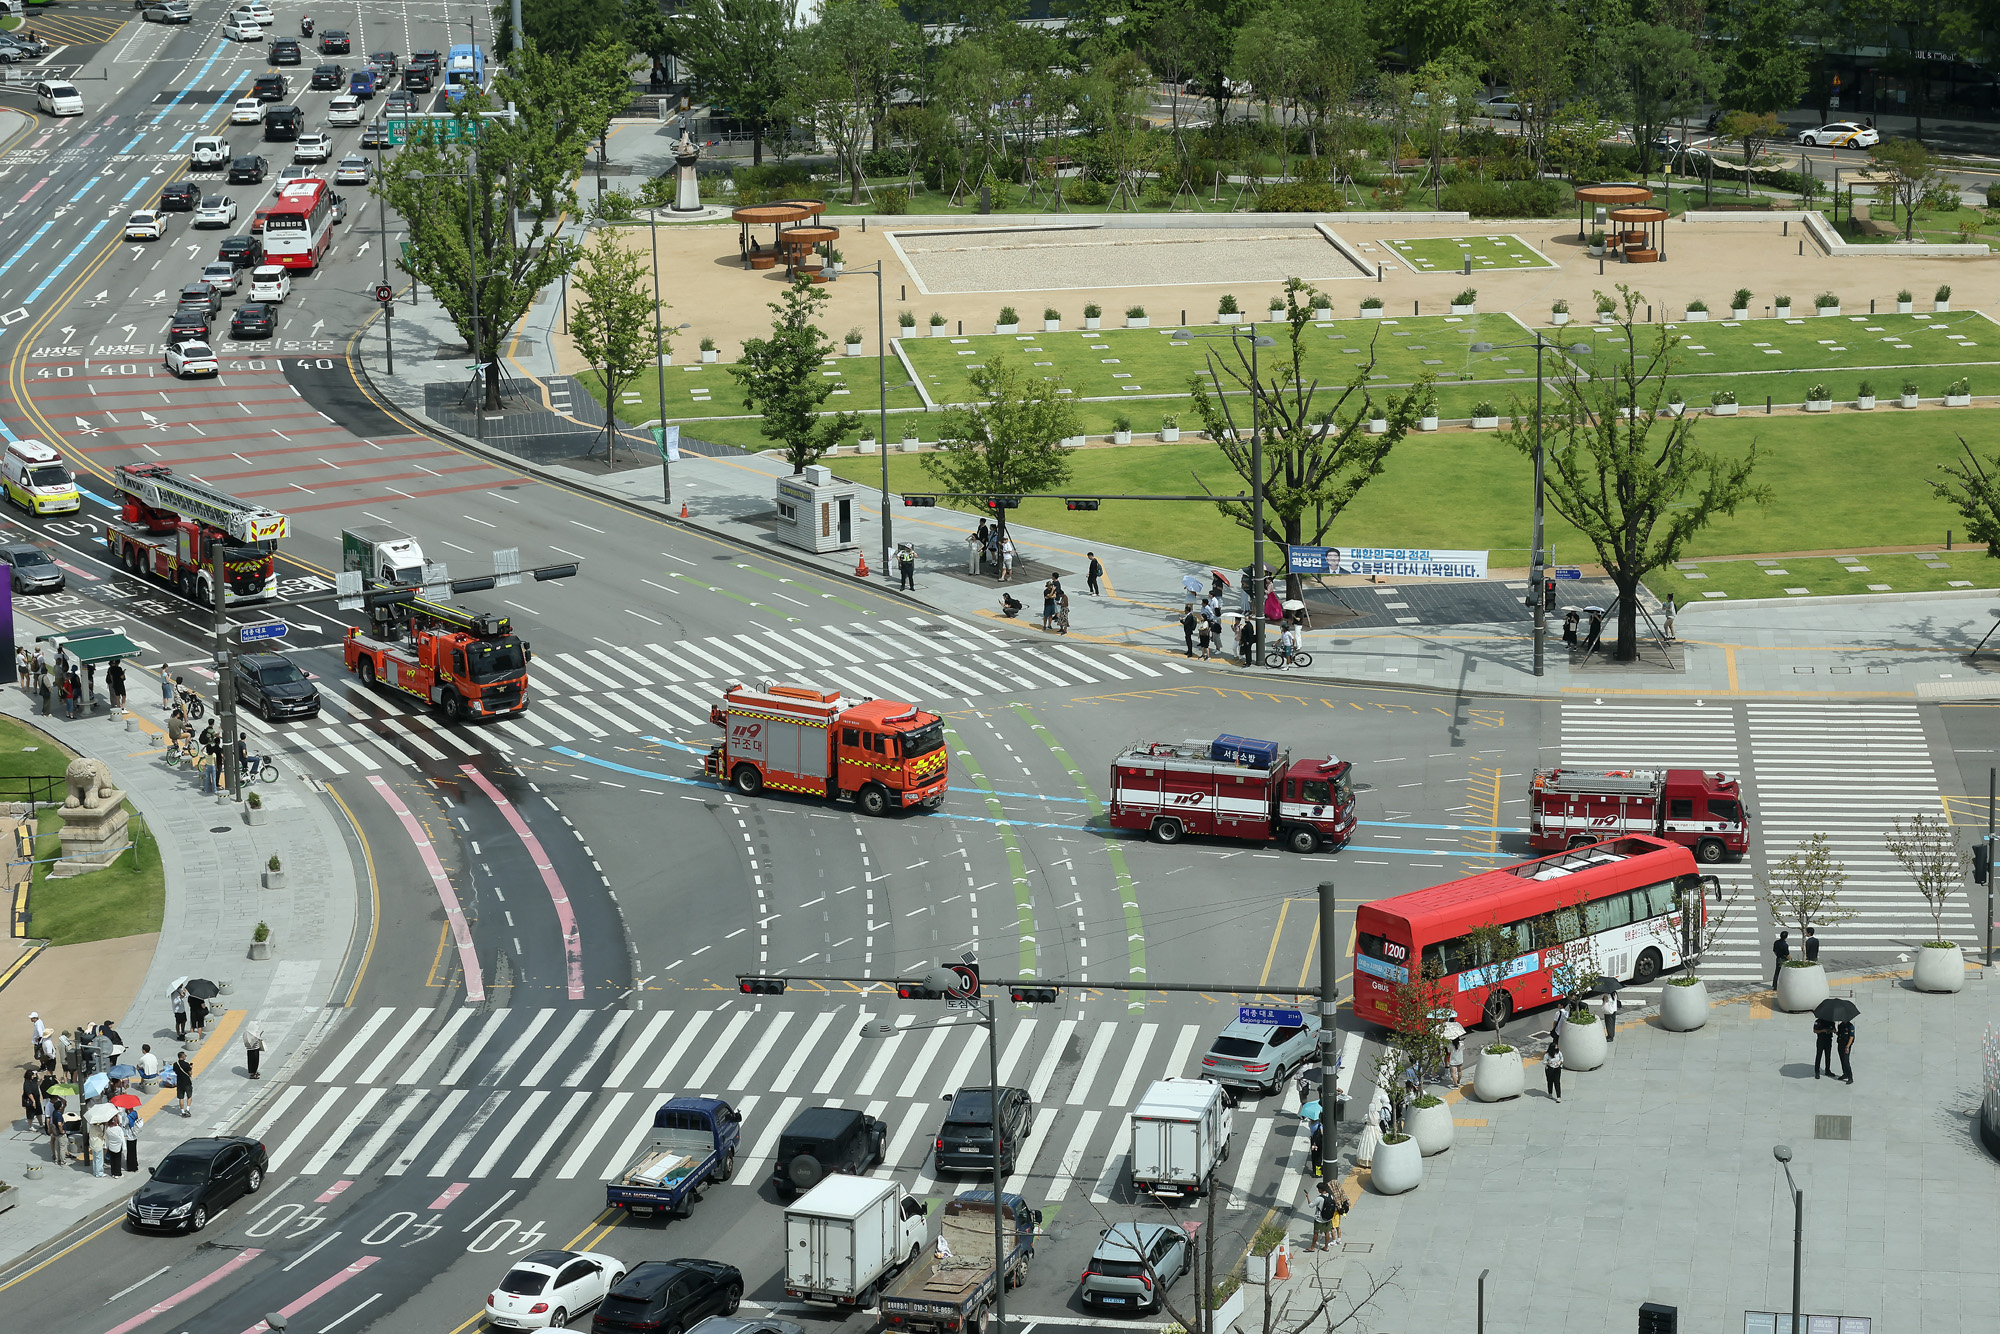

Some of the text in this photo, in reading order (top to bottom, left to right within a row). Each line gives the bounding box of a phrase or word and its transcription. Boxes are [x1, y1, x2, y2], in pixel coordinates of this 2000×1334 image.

[32, 345, 84, 357] 삼청동
[94, 344, 146, 356] 삼청동
[100, 364, 137, 375] 40
[229, 360, 266, 371] 40
[297, 358, 334, 370] 40
[37, 366, 74, 378] 40
[43, 520, 98, 537] 40
[259, 523, 279, 536] 119
[1351, 549, 1433, 562] 대한민국의 전진,
[1291, 557, 1322, 568] 곽상언
[1351, 561, 1480, 578] 오늘부터 다시 시작입니다.
[243, 627, 267, 636] 세종대로
[406, 669, 416, 678] 119
[732, 723, 762, 739] 119
[731, 737, 762, 752] 구조대
[1223, 749, 1256, 763] 서울소방
[1173, 791, 1206, 806] 119
[1591, 814, 1619, 827] 119
[1384, 942, 1405, 960] 1200
[1565, 941, 1590, 959] 1200
[1372, 981, 1389, 993] GBUS
[1242, 1009, 1275, 1018] 세종대로
[1241, 1017, 1278, 1025] Sejong-daero
[244, 1203, 327, 1239] 40
[360, 1211, 444, 1248] 40
[466, 1218, 548, 1255] 40
